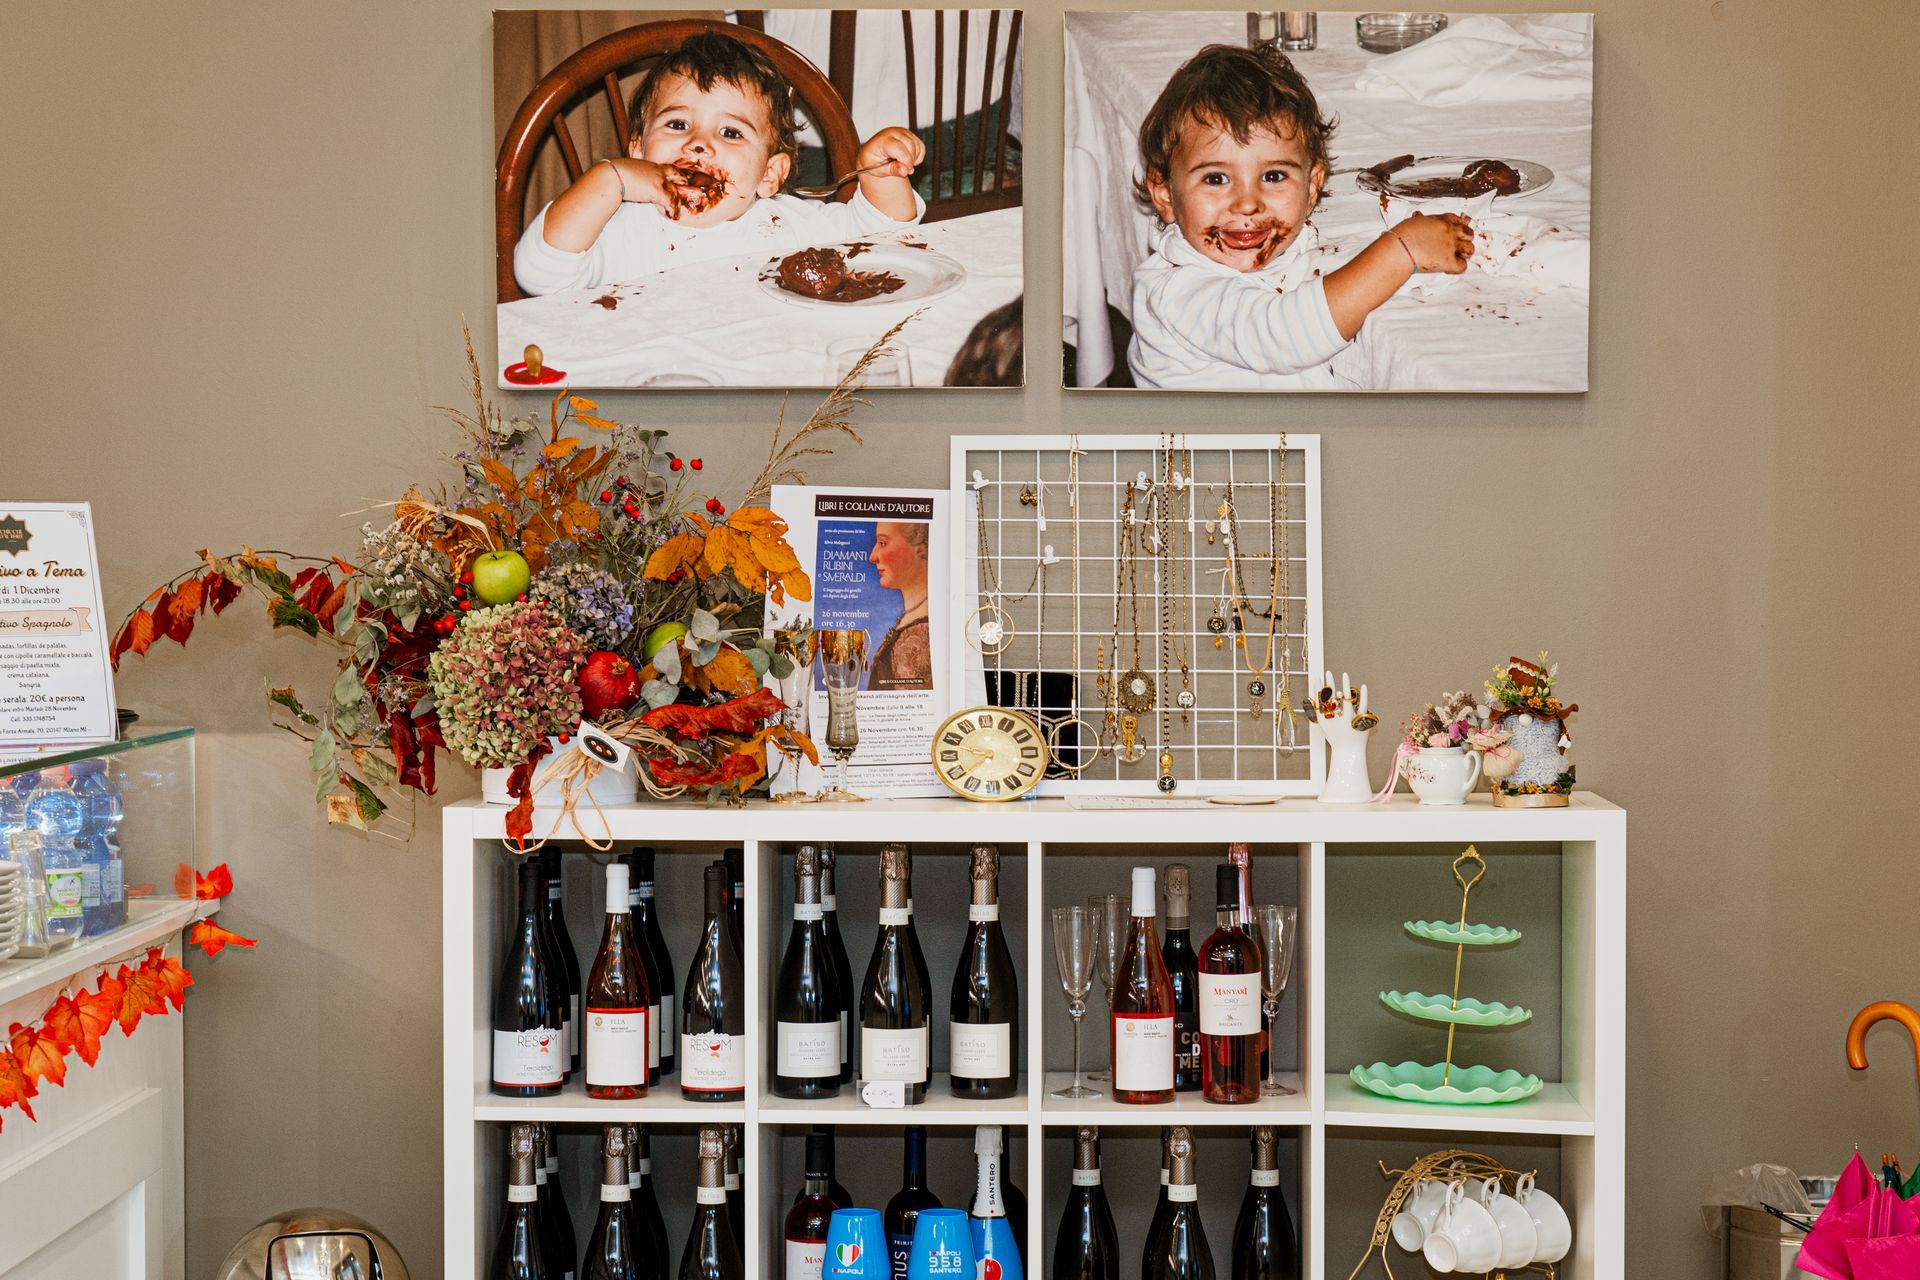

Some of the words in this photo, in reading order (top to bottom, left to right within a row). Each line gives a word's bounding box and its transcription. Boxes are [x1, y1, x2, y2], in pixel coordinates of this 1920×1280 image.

[818, 501, 837, 512] LIBRI
[838, 502, 843, 510] E
[845, 502, 886, 512] COLLANE
[888, 503, 930, 514] D'AUTORE
[823, 550, 867, 561] DIAMANTI
[26, 567, 38, 577] a
[43, 560, 86, 577] Tema
[823, 560, 853, 571] RUBINI
[822, 572, 866, 583] SMERALDI
[20, 585, 60, 595] Dicembre
[822, 610, 831, 619] 26
[832, 610, 869, 619] novembre
[22, 617, 72, 631] Spagnolo
[19, 681, 41, 690] Sangria
[29, 694, 47, 703] 20€
[55, 695, 85, 704] persona
[517, 1034, 558, 1048] RESOM
[690, 1038, 732, 1052] RESOM
[804, 1256, 823, 1264] MAN
[837, 1267, 864, 1275] NAPOLI
